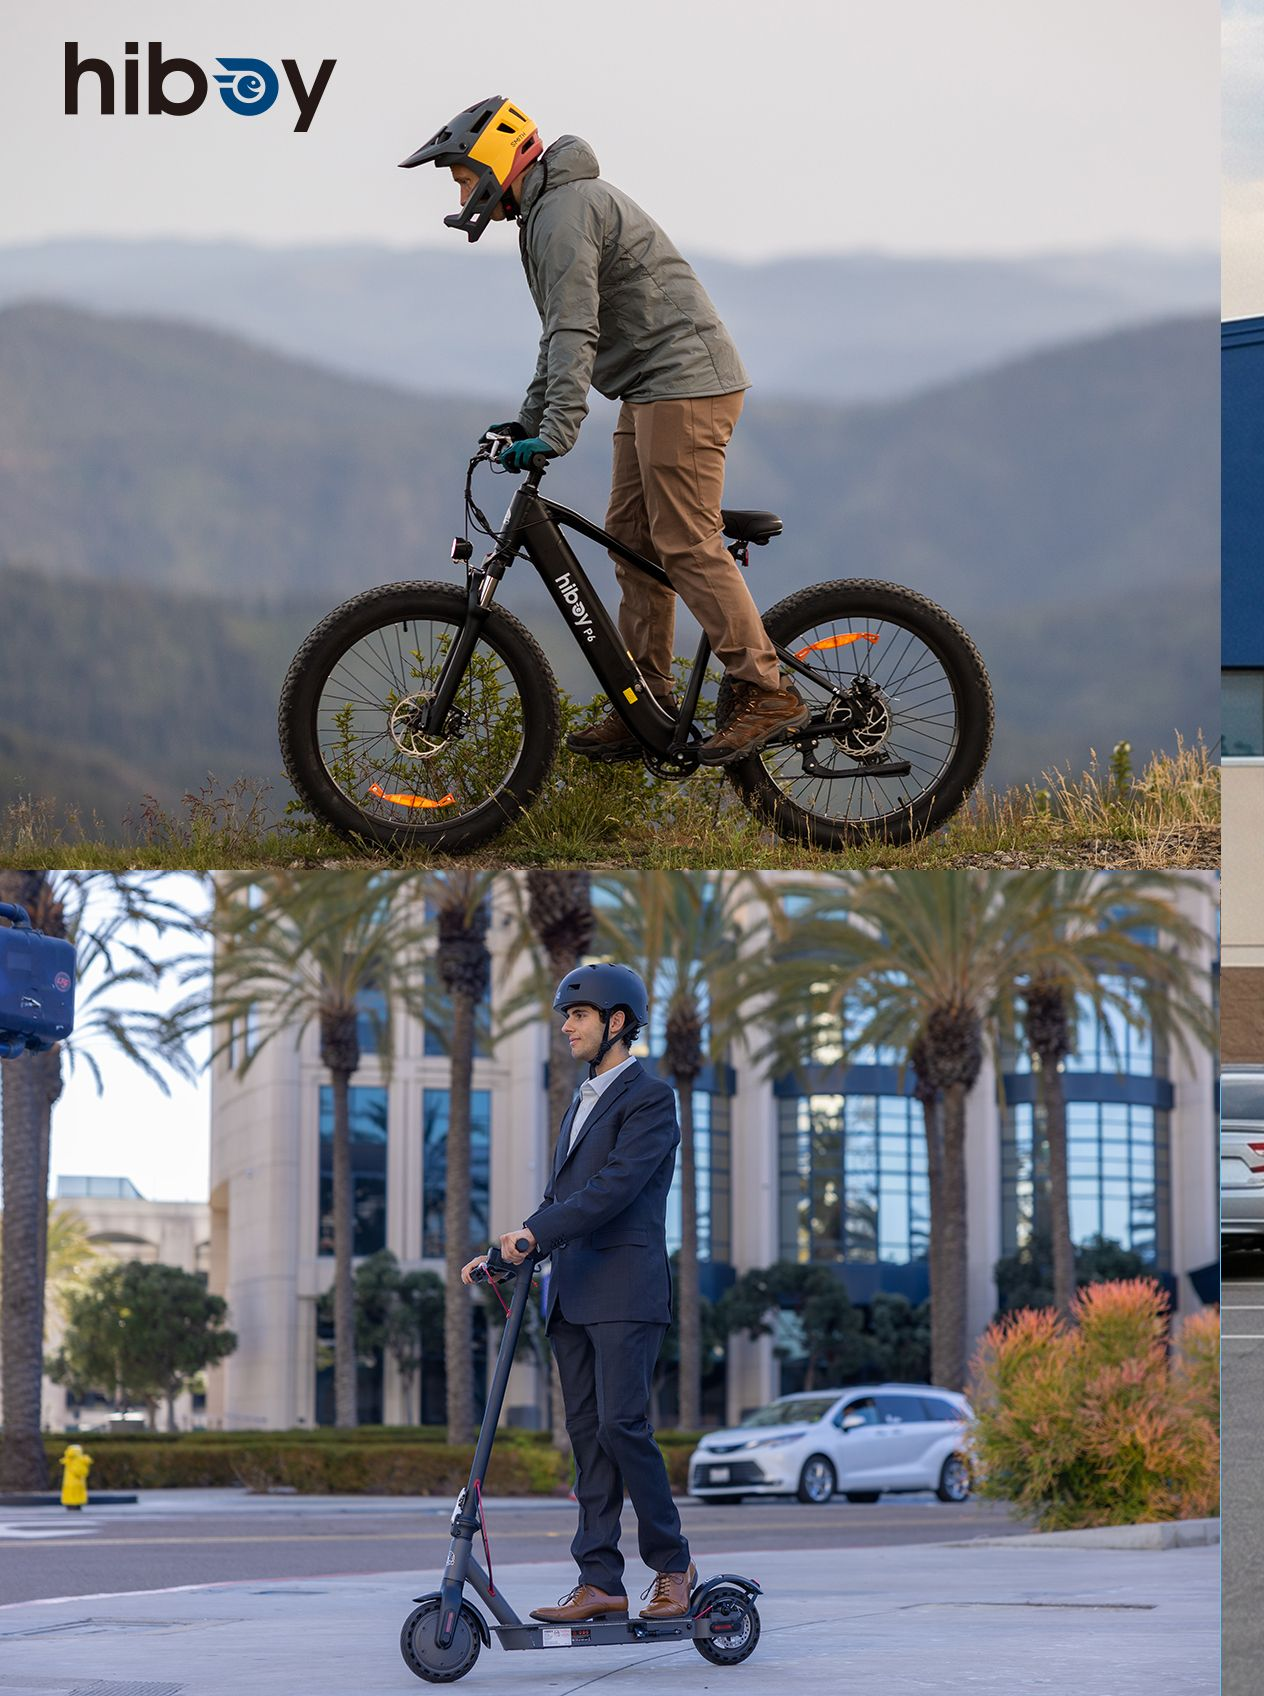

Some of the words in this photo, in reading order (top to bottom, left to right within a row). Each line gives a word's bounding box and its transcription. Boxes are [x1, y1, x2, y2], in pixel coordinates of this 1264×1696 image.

[510, 131, 527, 148] SMITH
[554, 572, 593, 626] hiboy
[583, 627, 597, 642] P6
